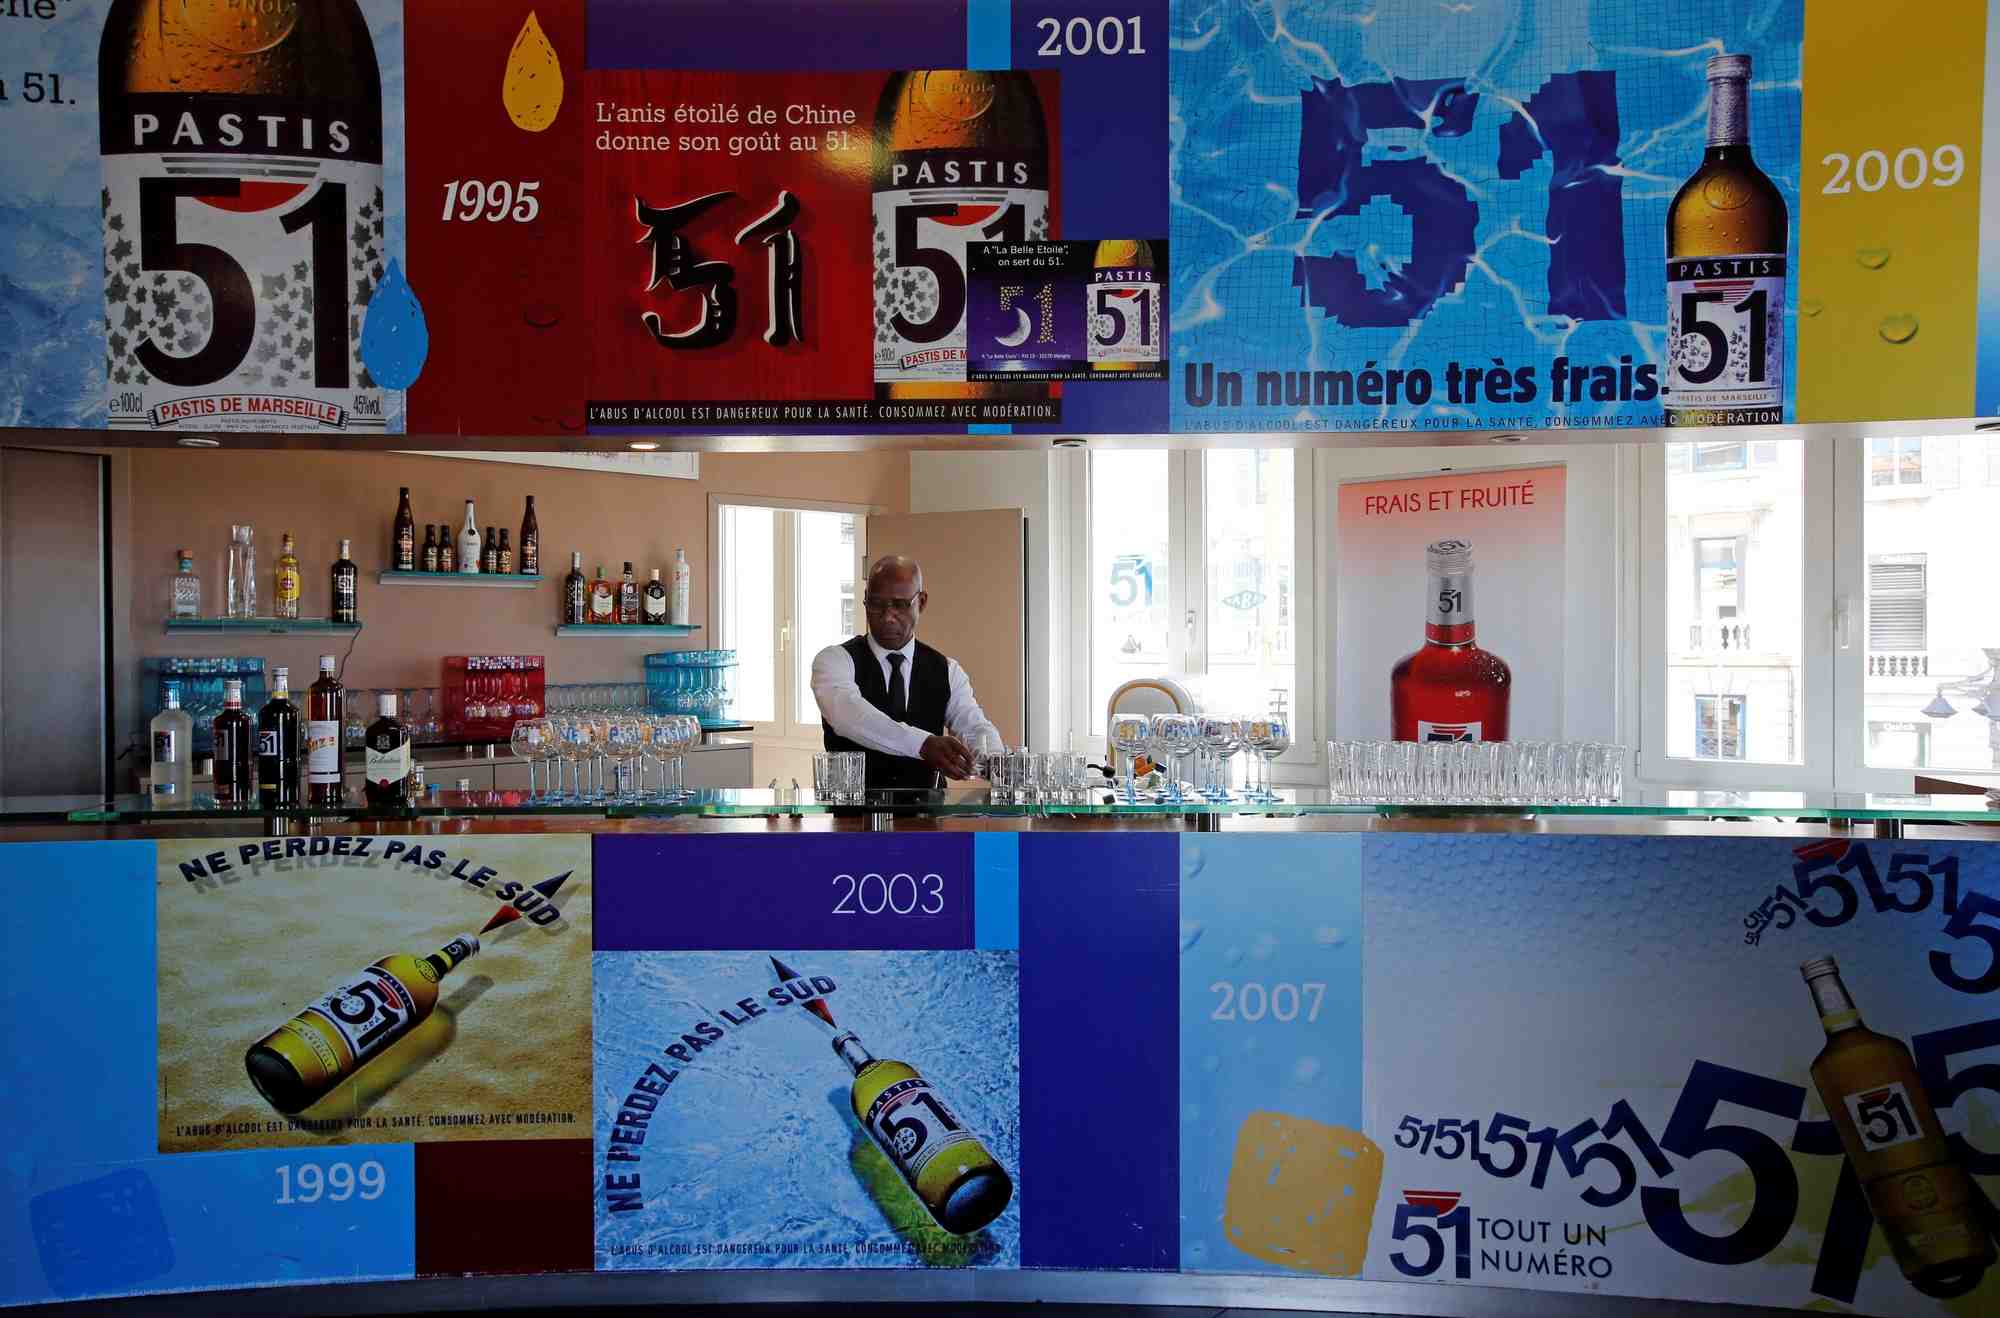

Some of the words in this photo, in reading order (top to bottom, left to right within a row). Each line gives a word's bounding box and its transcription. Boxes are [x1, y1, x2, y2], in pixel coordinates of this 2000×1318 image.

[1036, 15, 1147, 57] 2001
[23, 72, 76, 104] 51.
[133, 111, 351, 153] PASTIS
[596, 102, 666, 123] L'anis
[674, 103, 740, 123] étoilé
[747, 104, 777, 124] de
[785, 103, 856, 125] Chine
[595, 130, 671, 151] donne
[679, 134, 721, 151] son
[728, 131, 781, 156] goût
[789, 134, 817, 151] au
[891, 160, 1029, 186] PASTIS
[1820, 143, 1966, 196] 2009
[442, 179, 541, 223] 1995
[1293, 69, 1628, 330] 51
[633, 188, 804, 350] 51
[983, 246, 990, 254] A
[1010, 246, 1034, 254] Belle
[998, 258, 1010, 266] on
[1012, 257, 1031, 266] sert
[1033, 257, 1045, 266] du
[1048, 257, 1065, 266] 51.
[1680, 261, 1770, 277] PASTIS
[133, 176, 350, 388] 51
[1095, 271, 1153, 282] PASTIS
[1094, 289, 1151, 346] 51
[1678, 290, 1768, 384] 51
[905, 350, 940, 366] PASTIS
[943, 350, 957, 360] DE
[1184, 362, 1243, 407] Un
[1256, 360, 1434, 407] numéro
[1445, 357, 1537, 405] très
[1551, 354, 1670, 403] frais.
[160, 397, 216, 420] PASTIS
[220, 397, 243, 412] DE
[247, 398, 337, 421] MARSEILLE
[590, 407, 628, 420] L'ABUS
[633, 407, 687, 420] D'ALCOOL
[692, 407, 710, 419] EST
[716, 407, 779, 419] DANGEREUX
[784, 406, 813, 419] POUR
[818, 406, 829, 418] LA
[835, 403, 873, 418] SANTÉ.
[879, 405, 945, 418] CONSOMMEZ
[951, 405, 977, 417] AVEC
[982, 402, 1057, 417] MODÉRATION.
[1304, 419, 1329, 430] EST
[1335, 418, 1418, 430] DANGEREUX
[1424, 418, 1459, 429] POUR
[1466, 417, 1482, 428] LA
[1545, 415, 1634, 427] CONSOMMEZ
[1365, 492, 1422, 515] FRAIS
[1428, 490, 1453, 511] ET
[1460, 480, 1535, 510] FRUITÉ
[1109, 558, 1153, 607] 51
[1438, 590, 1462, 613] 51
[258, 734, 274, 754] 51
[178, 851, 233, 882] NE
[238, 836, 375, 866] PERDEZ
[383, 840, 447, 870] PAS
[450, 858, 498, 889] LE
[496, 881, 562, 927] SUD
[831, 873, 945, 915] 2003
[1883, 853, 1959, 916] 51
[719, 997, 767, 1026] LE
[767, 975, 837, 1006] SUD
[1209, 980, 1327, 1023] 2007
[329, 981, 402, 1050] 51
[664, 1021, 724, 1063] PAS
[376, 1117, 388, 1128] LA
[428, 1114, 485, 1127] CONSOMMEZ
[489, 1113, 512, 1125] AVEC
[607, 1063, 680, 1162] PERDEZ
[869, 1080, 925, 1120] PASTIS
[1856, 1091, 1918, 1145] 51
[879, 1092, 961, 1160] 51
[1394, 1114, 1436, 1155] 51
[1434, 1118, 1480, 1160] 51
[1478, 1112, 1559, 1190] 51
[1553, 1099, 1674, 1208] 51
[274, 1160, 387, 1205] 1999
[605, 1173, 644, 1213] NE
[1389, 1202, 1471, 1280] 51
[1477, 1217, 1551, 1243] TOUT
[1563, 1222, 1607, 1247] UN
[1480, 1248, 1613, 1279] NUMÉRO
